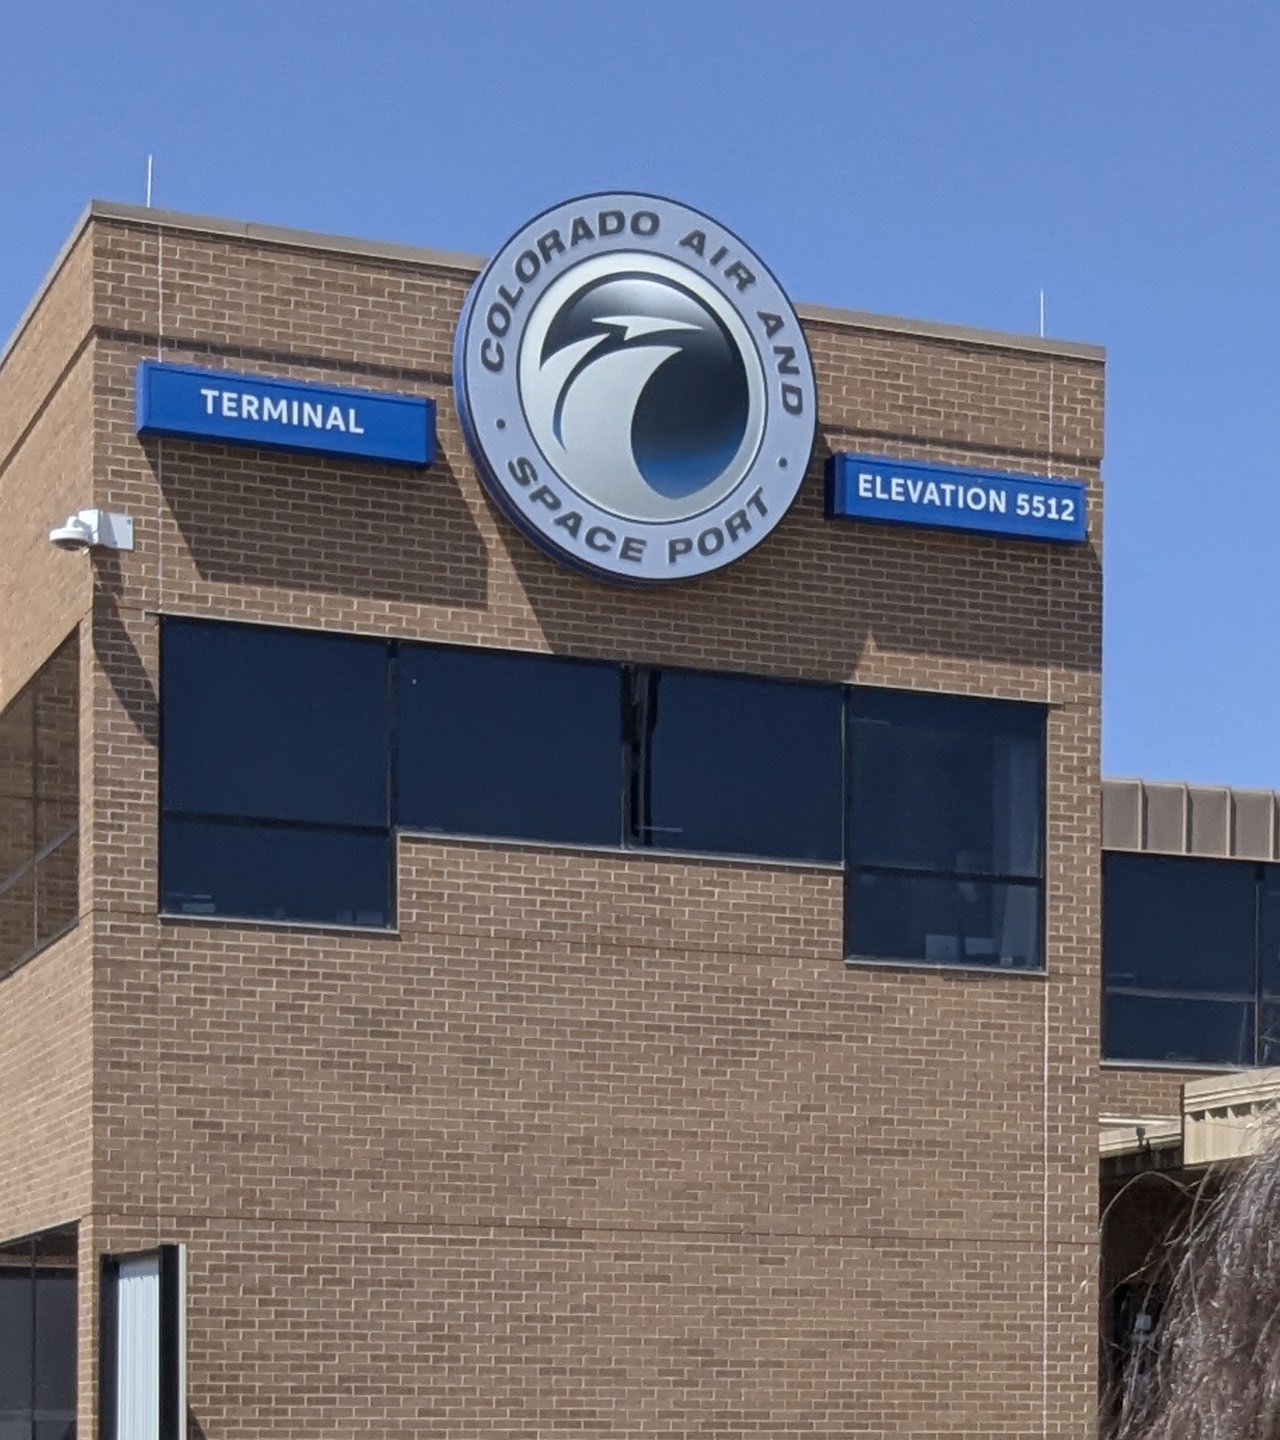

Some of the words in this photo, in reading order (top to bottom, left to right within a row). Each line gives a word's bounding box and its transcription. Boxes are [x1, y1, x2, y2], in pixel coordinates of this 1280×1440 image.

[480, 209, 660, 373] COLORADO
[679, 228, 757, 294] AIR
[755, 309, 804, 416] AND
[200, 388, 365, 434] TERMINAL
[507, 455, 648, 563] SPACE
[668, 486, 769, 564] PORT
[858, 473, 1007, 514] ELEVATION
[1015, 493, 1076, 522] 5512
